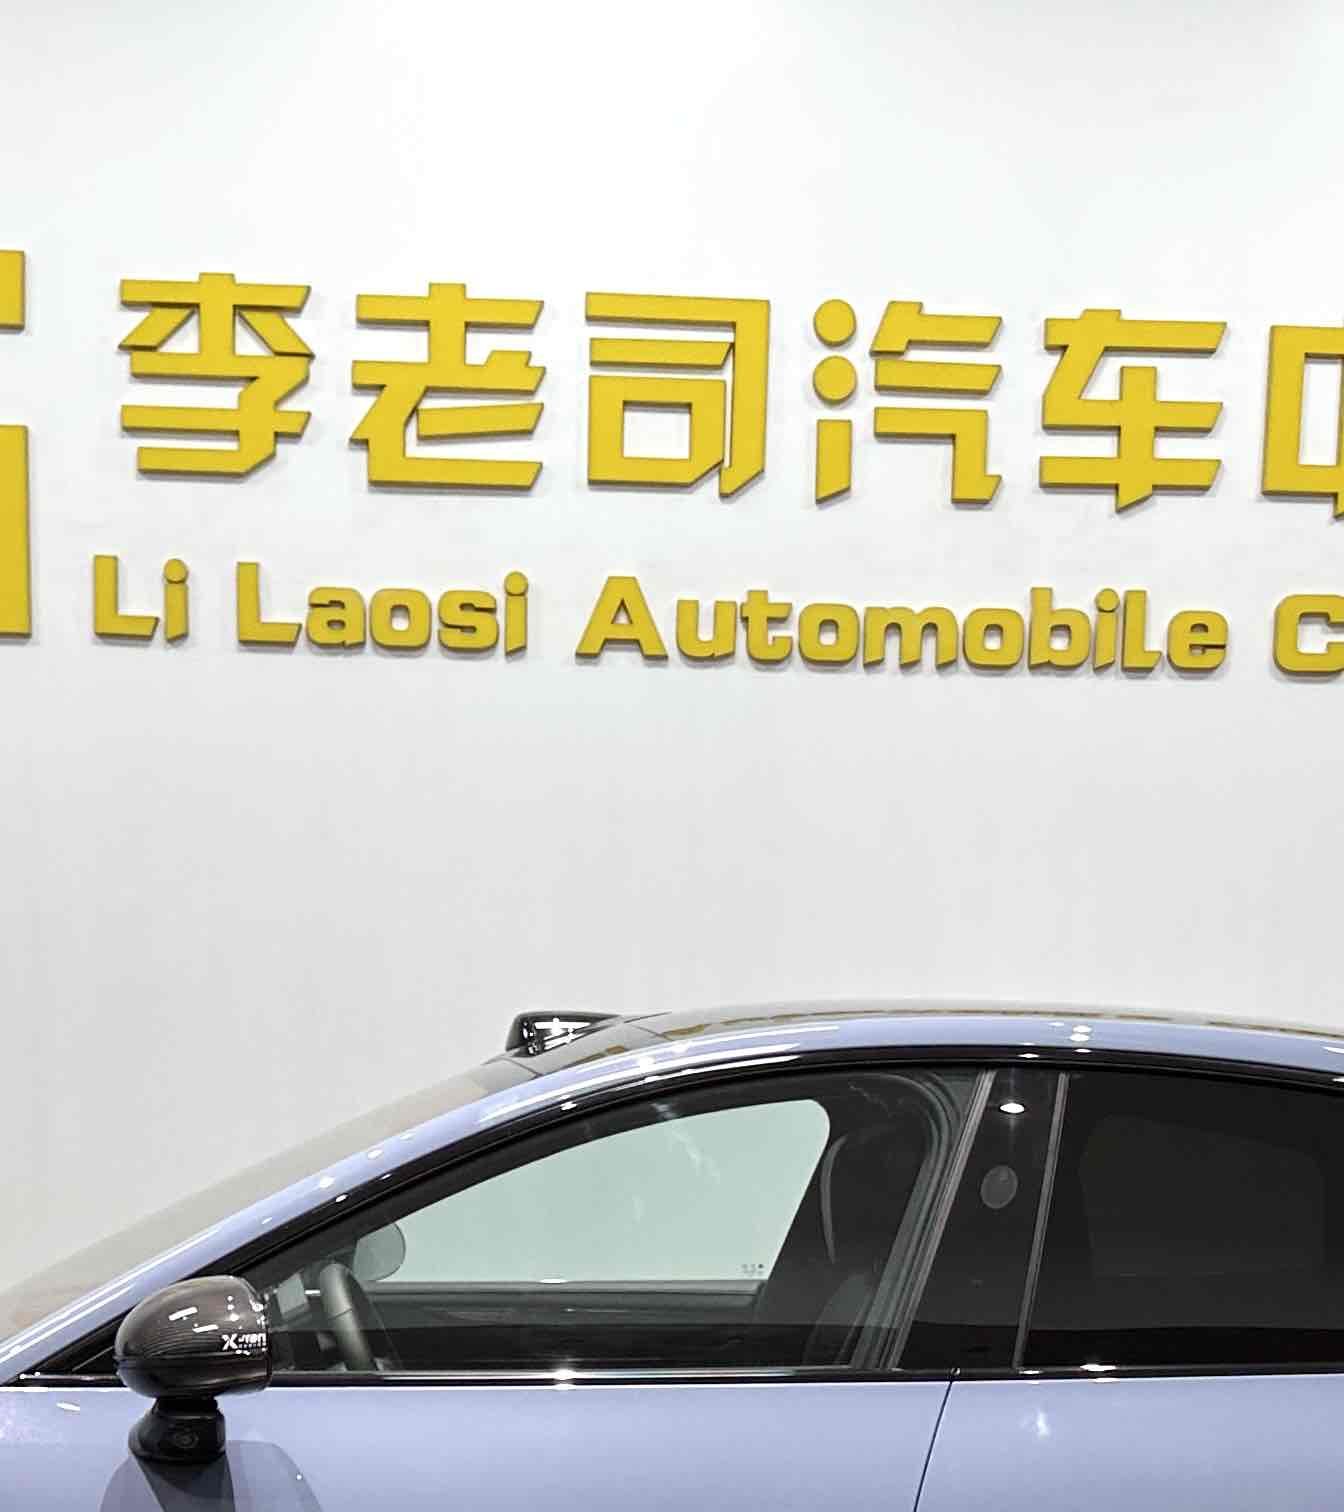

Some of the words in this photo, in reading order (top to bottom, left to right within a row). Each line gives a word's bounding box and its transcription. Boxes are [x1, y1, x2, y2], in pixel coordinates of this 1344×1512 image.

[93, 553, 189, 643] Li
[236, 560, 530, 656] Laosi
[575, 574, 1229, 674] Automobile
